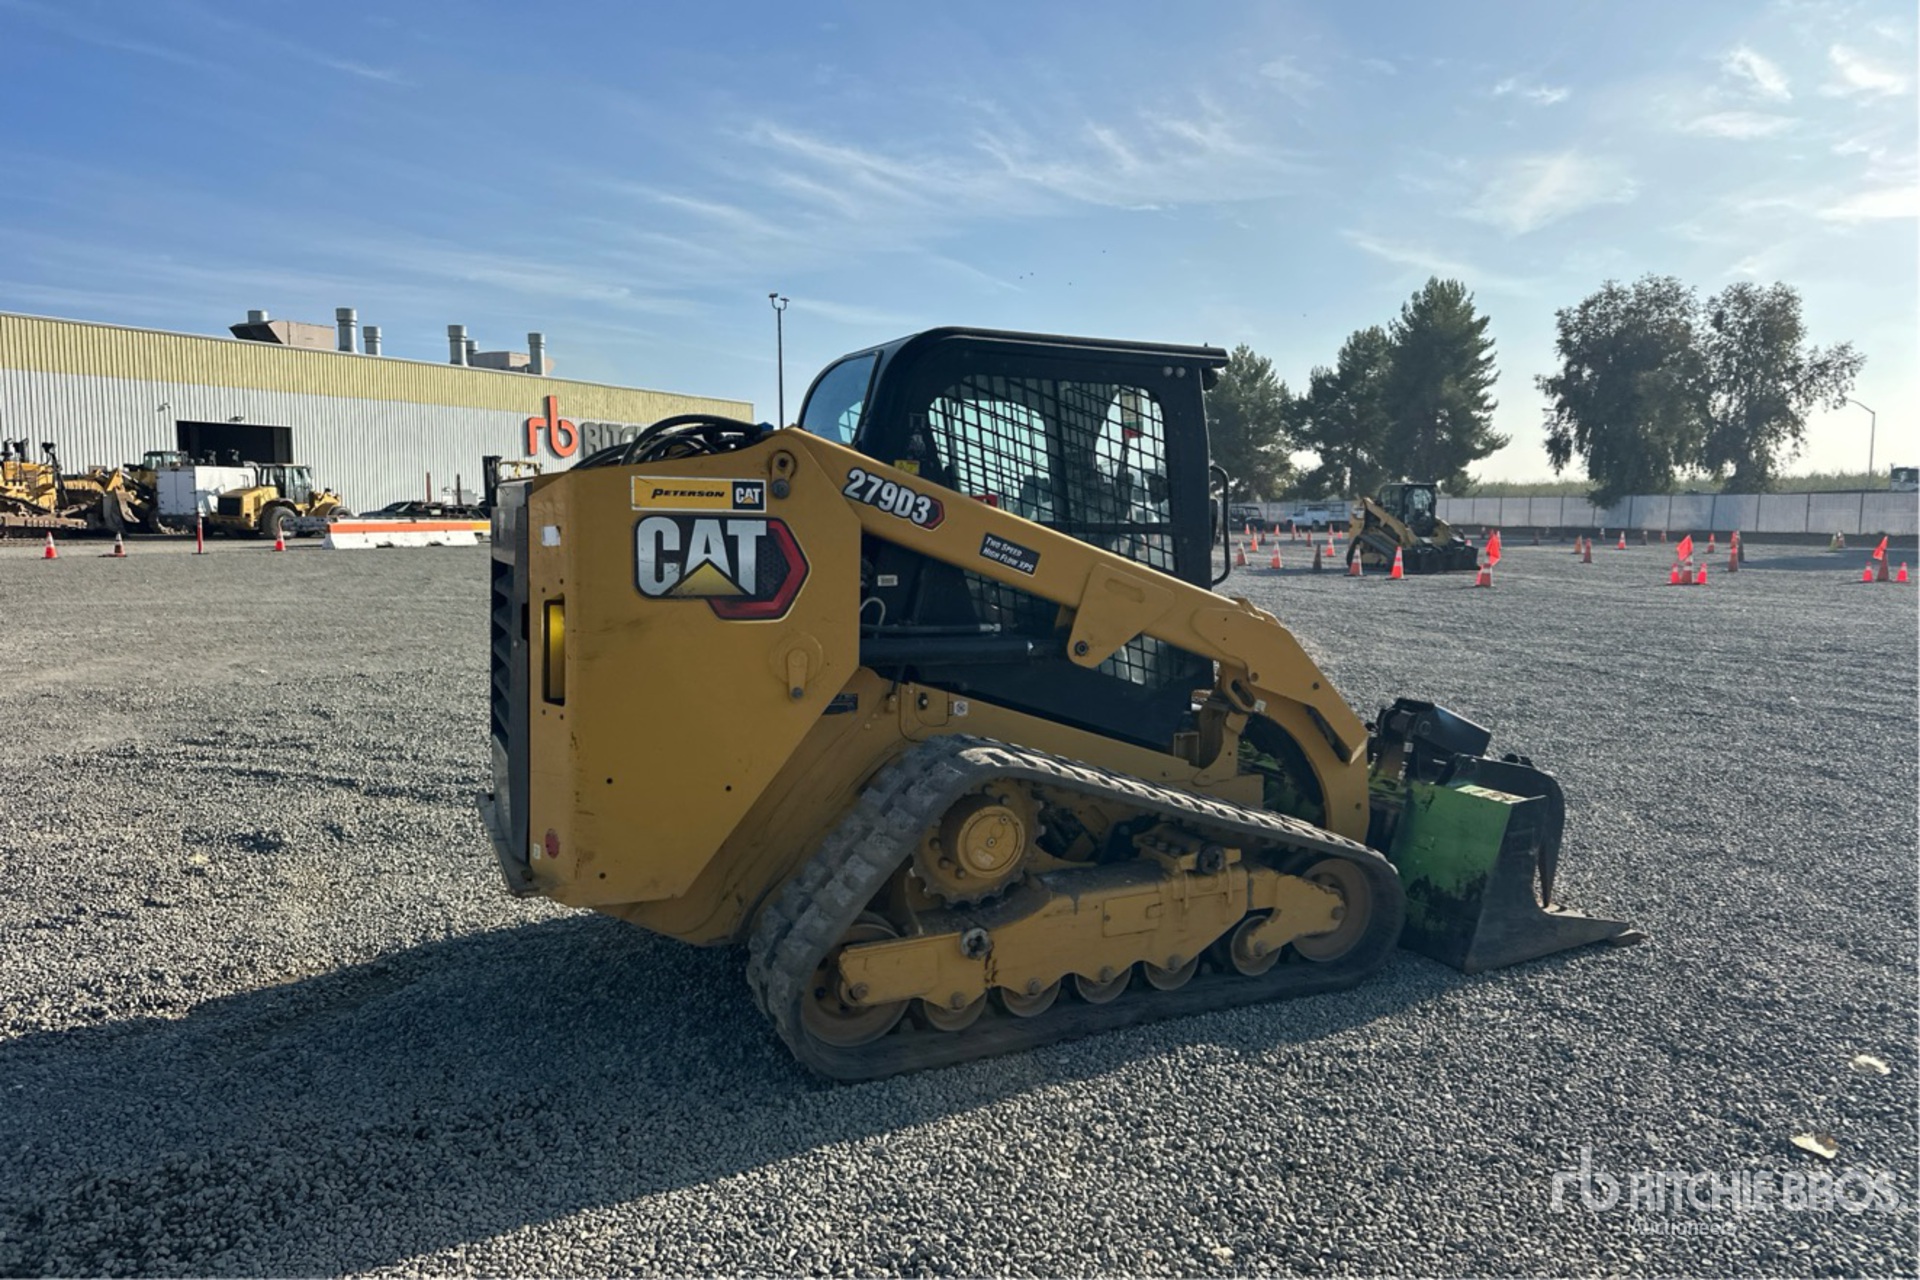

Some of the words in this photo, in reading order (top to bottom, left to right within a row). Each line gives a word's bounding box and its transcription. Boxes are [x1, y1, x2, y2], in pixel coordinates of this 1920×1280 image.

[526, 395, 579, 458] rb
[581, 421, 642, 456] RITC
[651, 488, 725, 499] PETERSON
[735, 487, 761, 504] CAT
[844, 468, 932, 525] 279D3
[636, 515, 767, 596] CAT
[1017, 560, 1035, 573] XPS
